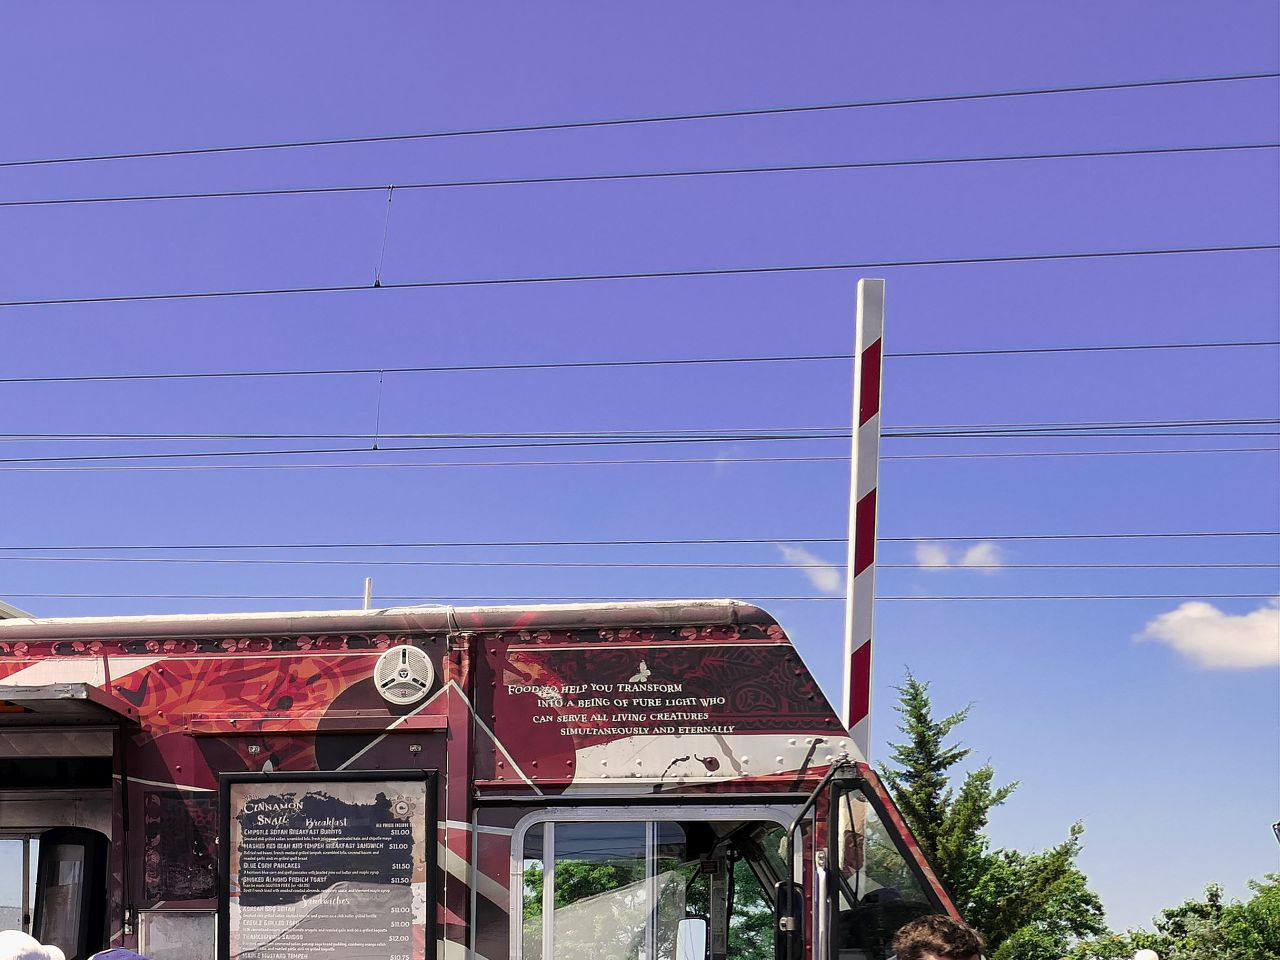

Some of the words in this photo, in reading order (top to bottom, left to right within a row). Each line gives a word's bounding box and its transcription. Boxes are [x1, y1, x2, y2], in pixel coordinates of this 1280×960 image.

[508, 684, 539, 695] FOOD
[561, 684, 588, 694] HELP
[591, 683, 613, 692] YOU
[616, 684, 682, 693] TRANSFORM
[538, 698, 563, 708] INTO
[567, 700, 574, 708] A
[578, 698, 610, 707] BEING
[614, 698, 629, 707] OF
[633, 698, 662, 706] PURE
[666, 698, 697, 706] LIGHT
[700, 697, 725, 706] WHO
[533, 714, 553, 723] CAN
[557, 714, 587, 723] SERVE
[590, 714, 608, 722] ALL
[612, 713, 646, 722] LIVING
[650, 712, 709, 721] CREATURES
[560, 727, 649, 735] SIMULTANEOUSLY
[653, 726, 675, 734] AND
[678, 725, 735, 734] ETERNALLY
[244, 801, 304, 814] CINNAMON
[257, 815, 289, 826] SNAIL
[305, 817, 347, 829] Breakfast
[301, 894, 350, 908] Sandwiches
